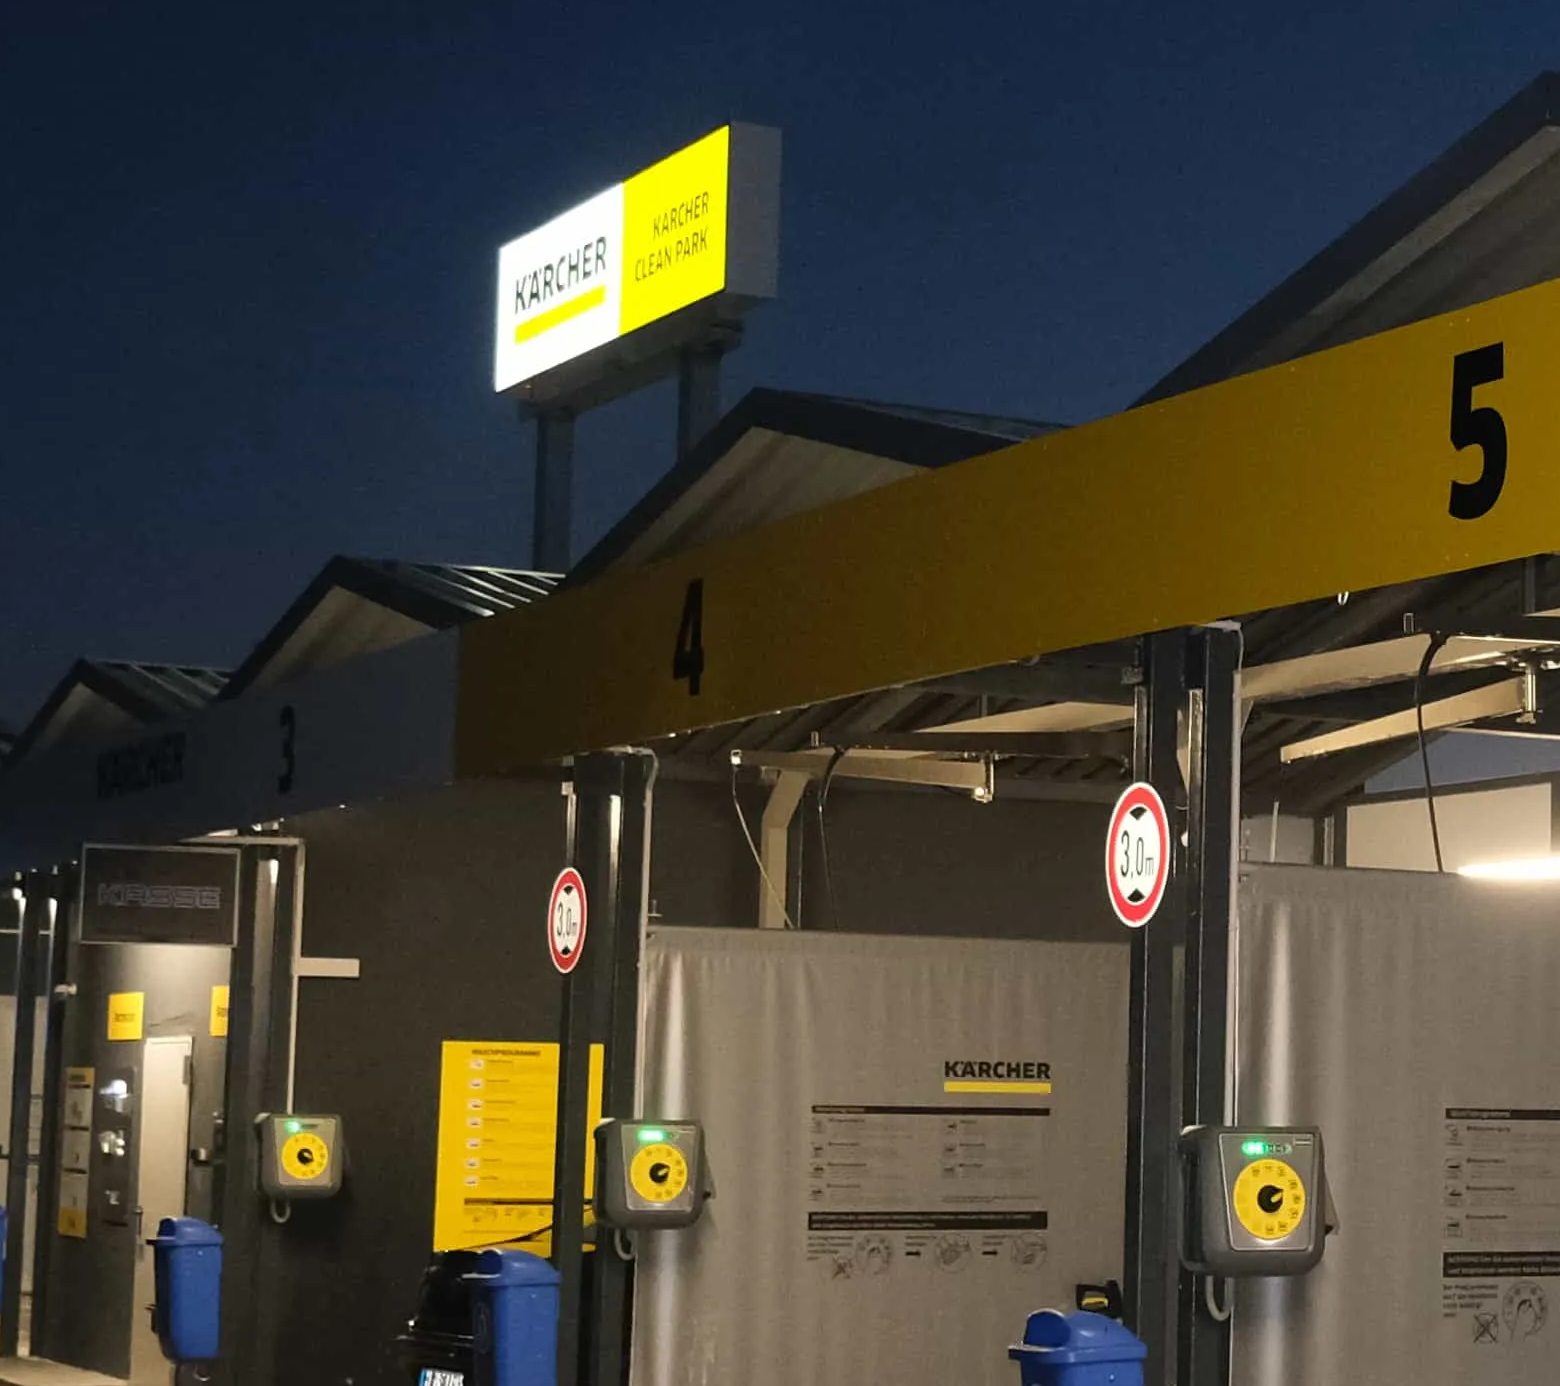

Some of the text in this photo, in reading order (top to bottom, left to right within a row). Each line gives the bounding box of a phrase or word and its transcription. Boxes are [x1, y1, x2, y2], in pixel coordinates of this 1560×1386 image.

[514, 236, 607, 315] KÄRCHER
[635, 228, 709, 282] CLEAN PARK
[1447, 342, 1509, 521] 5
[671, 577, 705, 696] 4
[945, 1060, 1051, 1079] KÄRCHER
